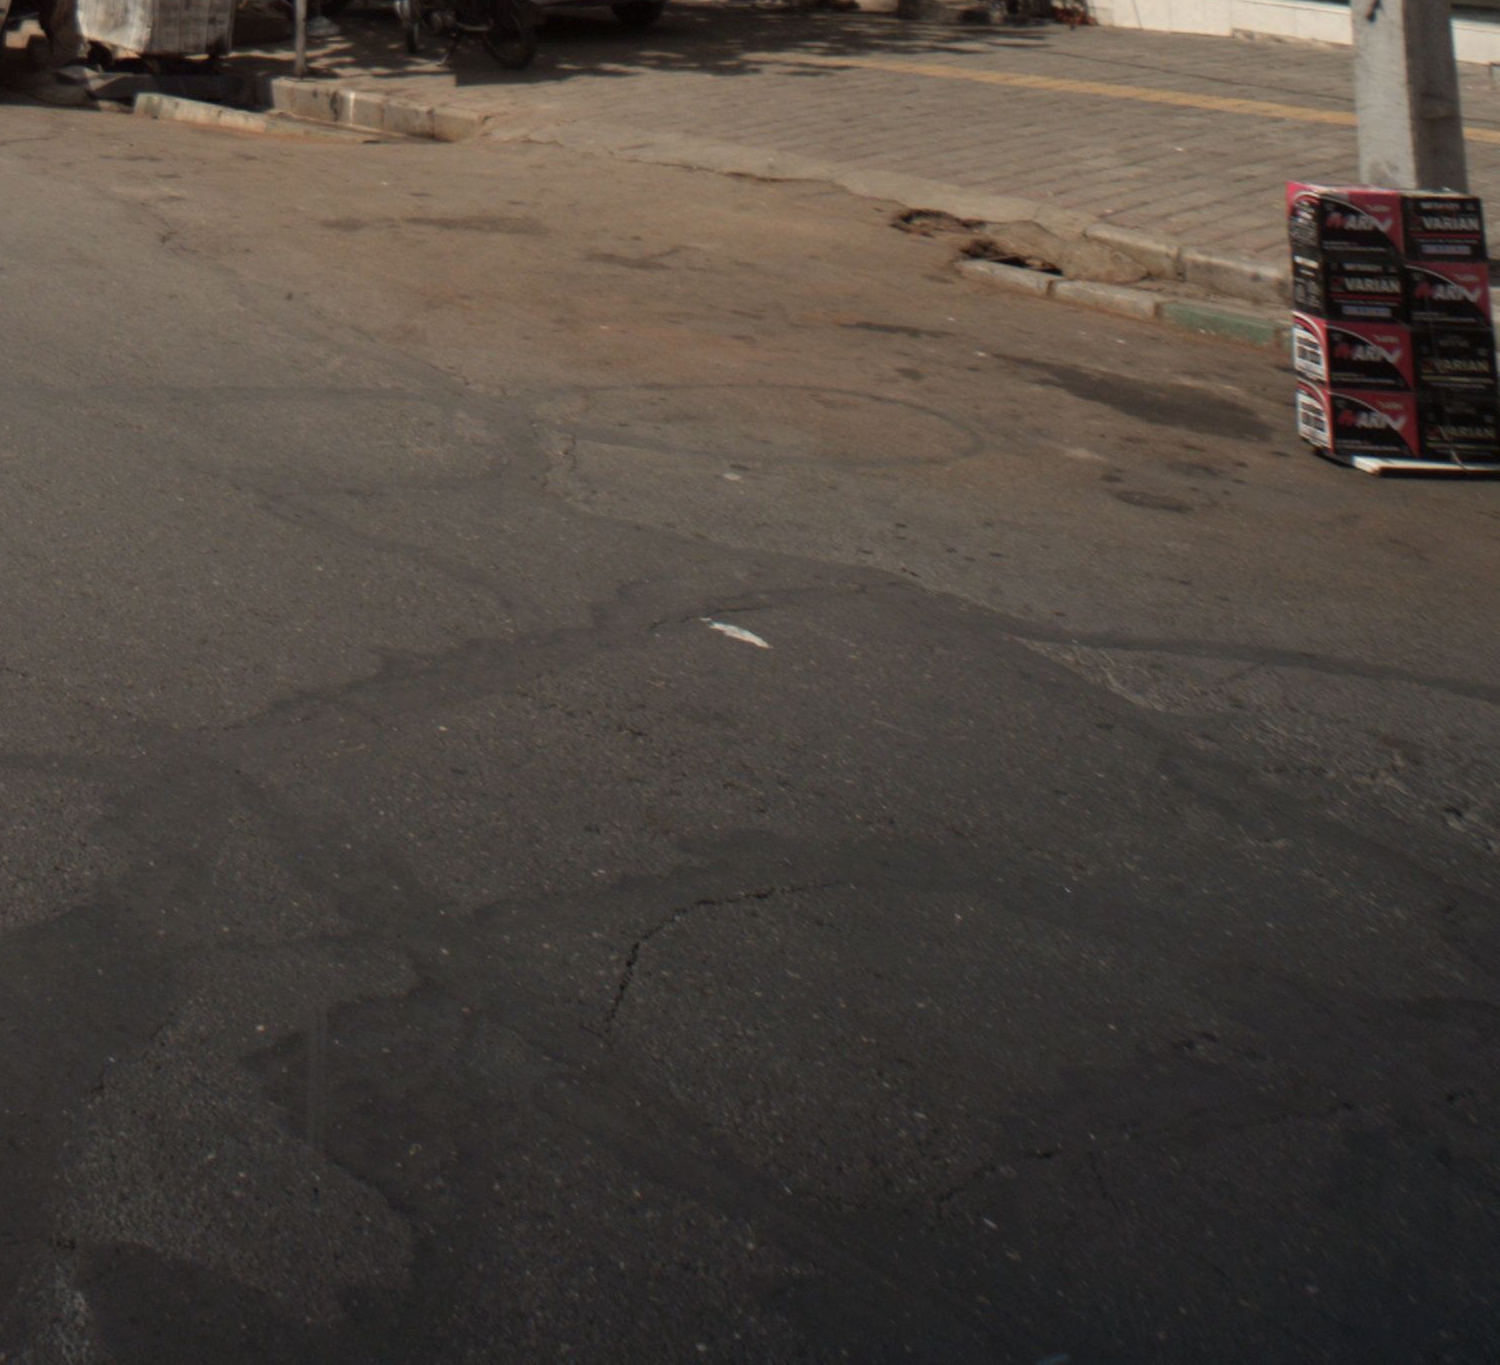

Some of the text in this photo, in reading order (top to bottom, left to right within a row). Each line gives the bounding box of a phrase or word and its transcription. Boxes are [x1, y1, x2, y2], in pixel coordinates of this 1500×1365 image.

[1420, 214, 1480, 232] VARIAN
[1344, 276, 1402, 294] VARIAN
[1434, 358, 1492, 375] VARIAN
